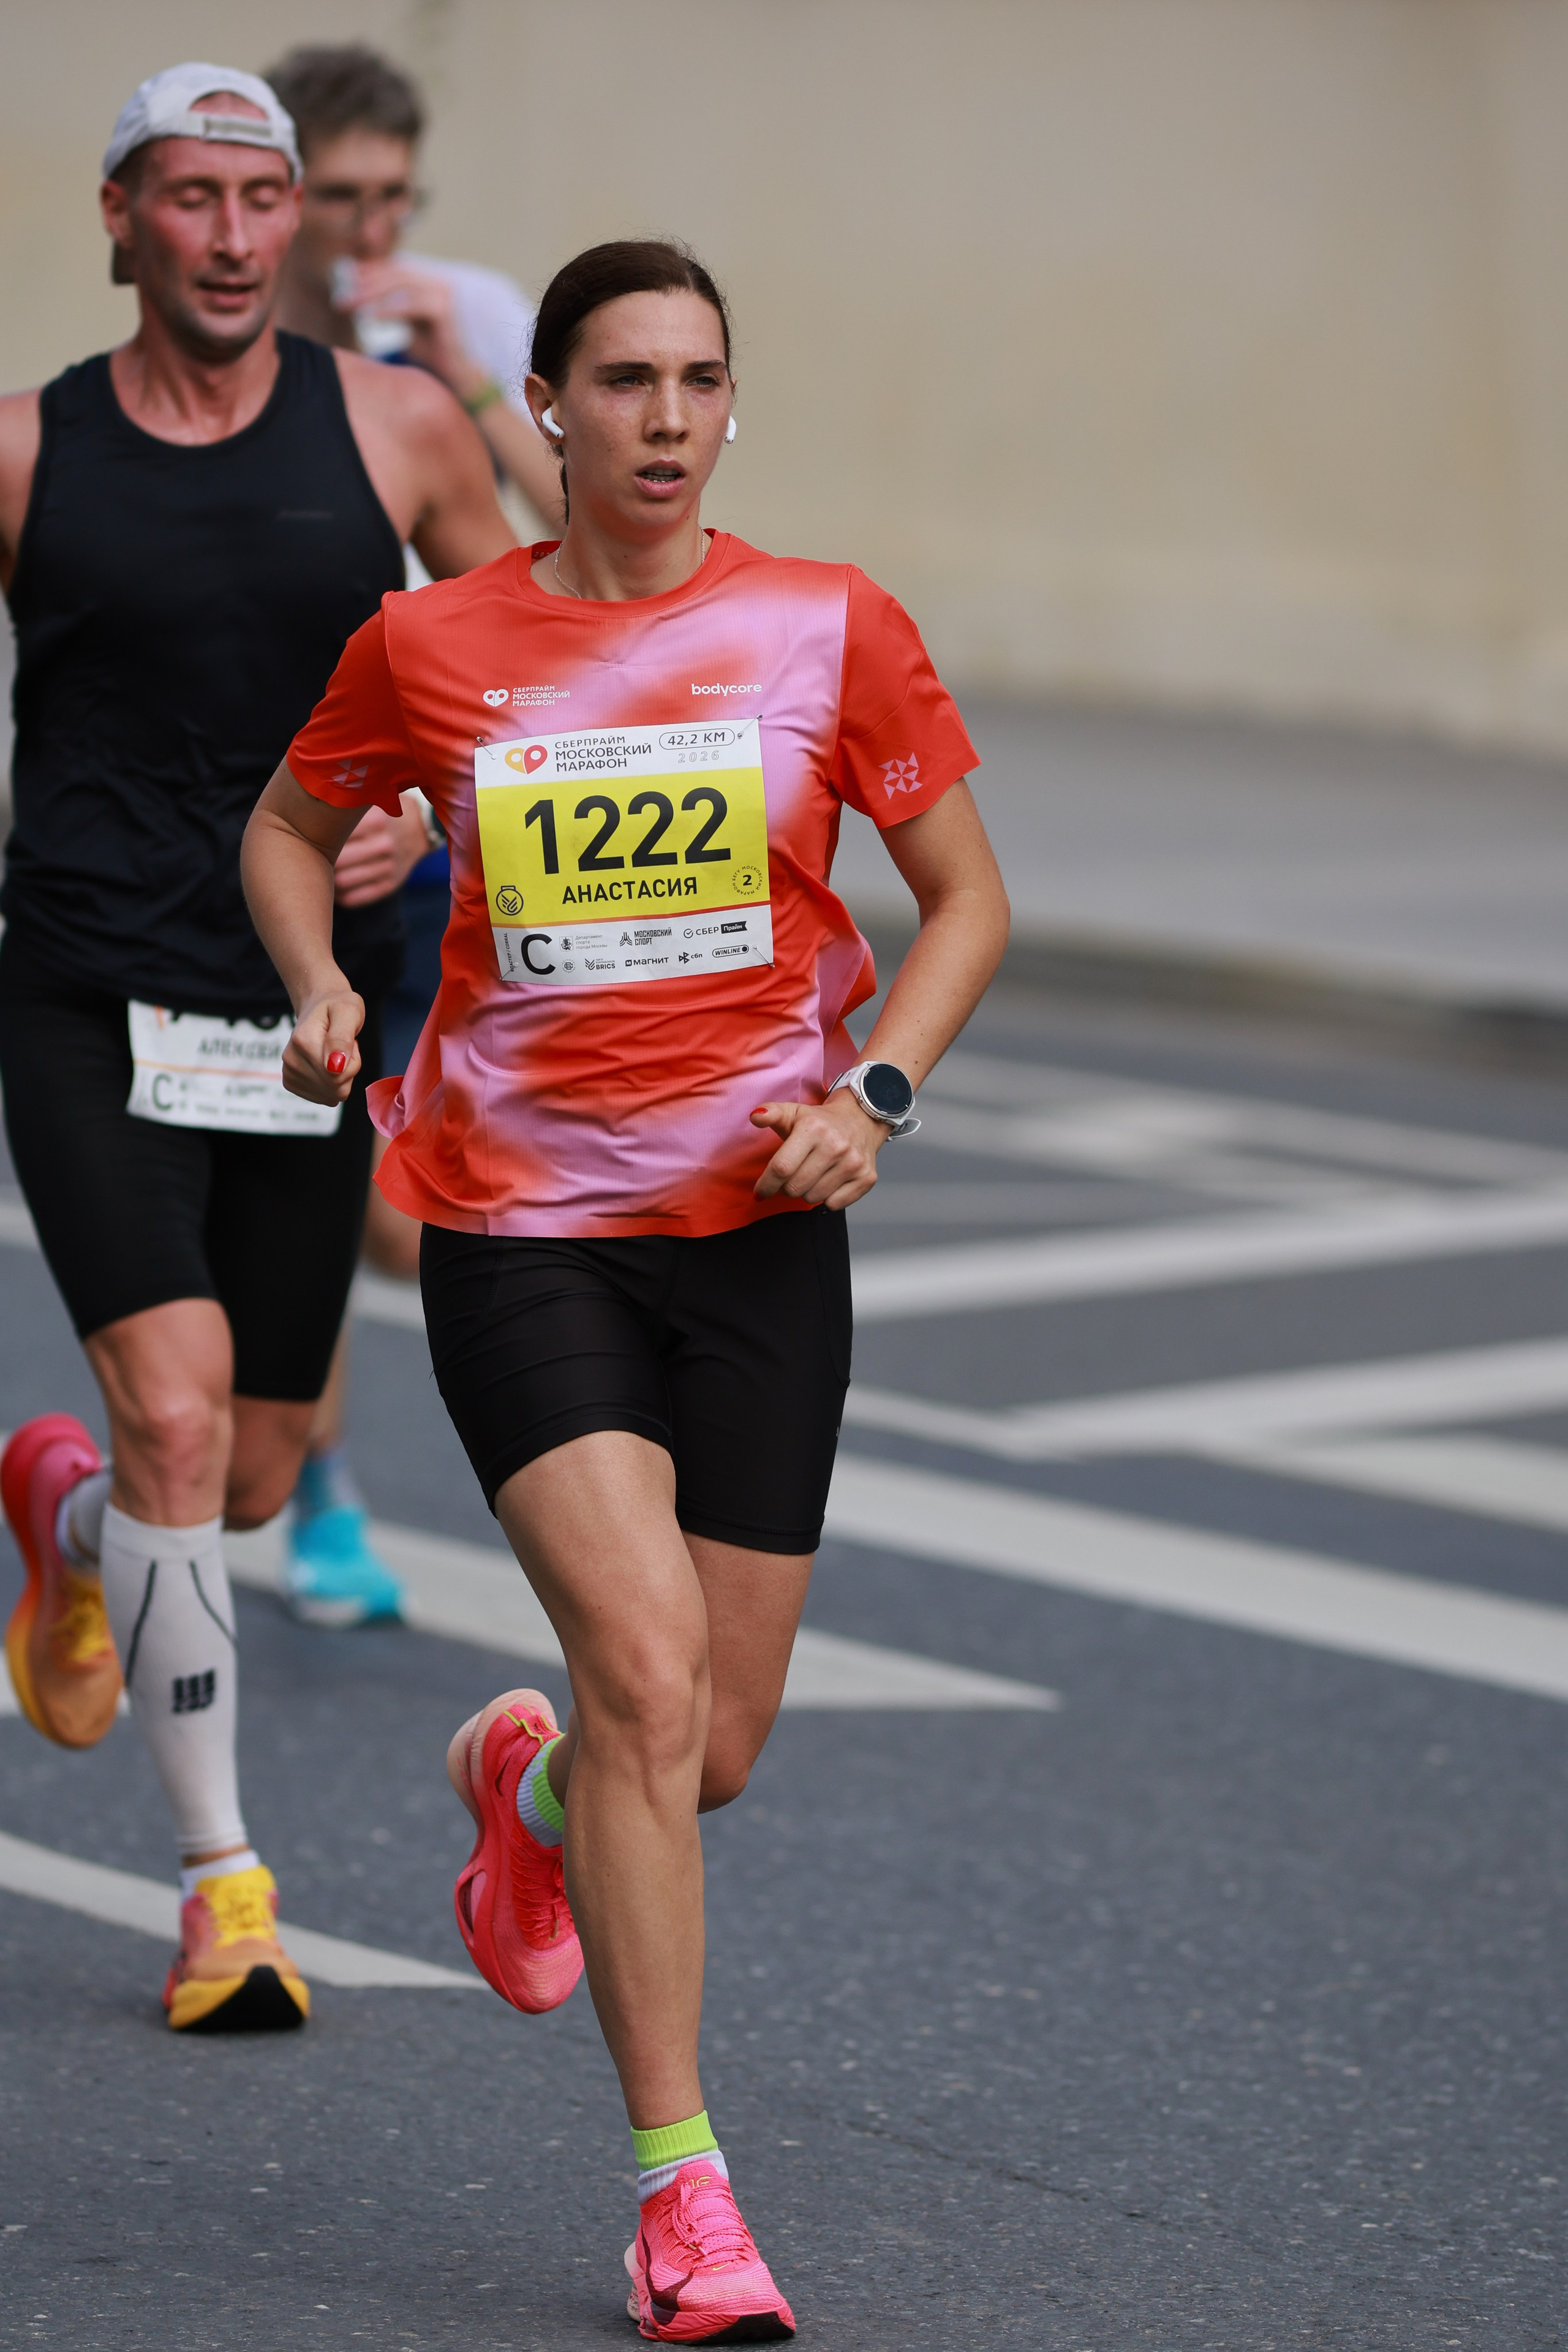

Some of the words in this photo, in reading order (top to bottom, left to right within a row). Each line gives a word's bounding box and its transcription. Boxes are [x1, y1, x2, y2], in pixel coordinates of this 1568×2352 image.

[513, 691, 570, 700] МОСКОВСКИЙ
[692, 683, 762, 696] bodycore
[555, 736, 625, 748] СБЕРПРАЙМ
[668, 734, 698, 746] 42,2
[556, 742, 652, 760] МОСКОВСКИЙ
[678, 750, 720, 763] 2026
[556, 758, 627, 772] МАРАФОН
[524, 787, 731, 875] 1222
[743, 875, 752, 886] 2
[562, 876, 698, 904] АНАСТАСИЯ
[634, 927, 672, 938] МОСКОВСКИЙ
[696, 926, 719, 935] СБЕР
[635, 937, 652, 946] СПОРТ
[715, 947, 741, 956] WINLINE
[633, 957, 669, 966] магнит
